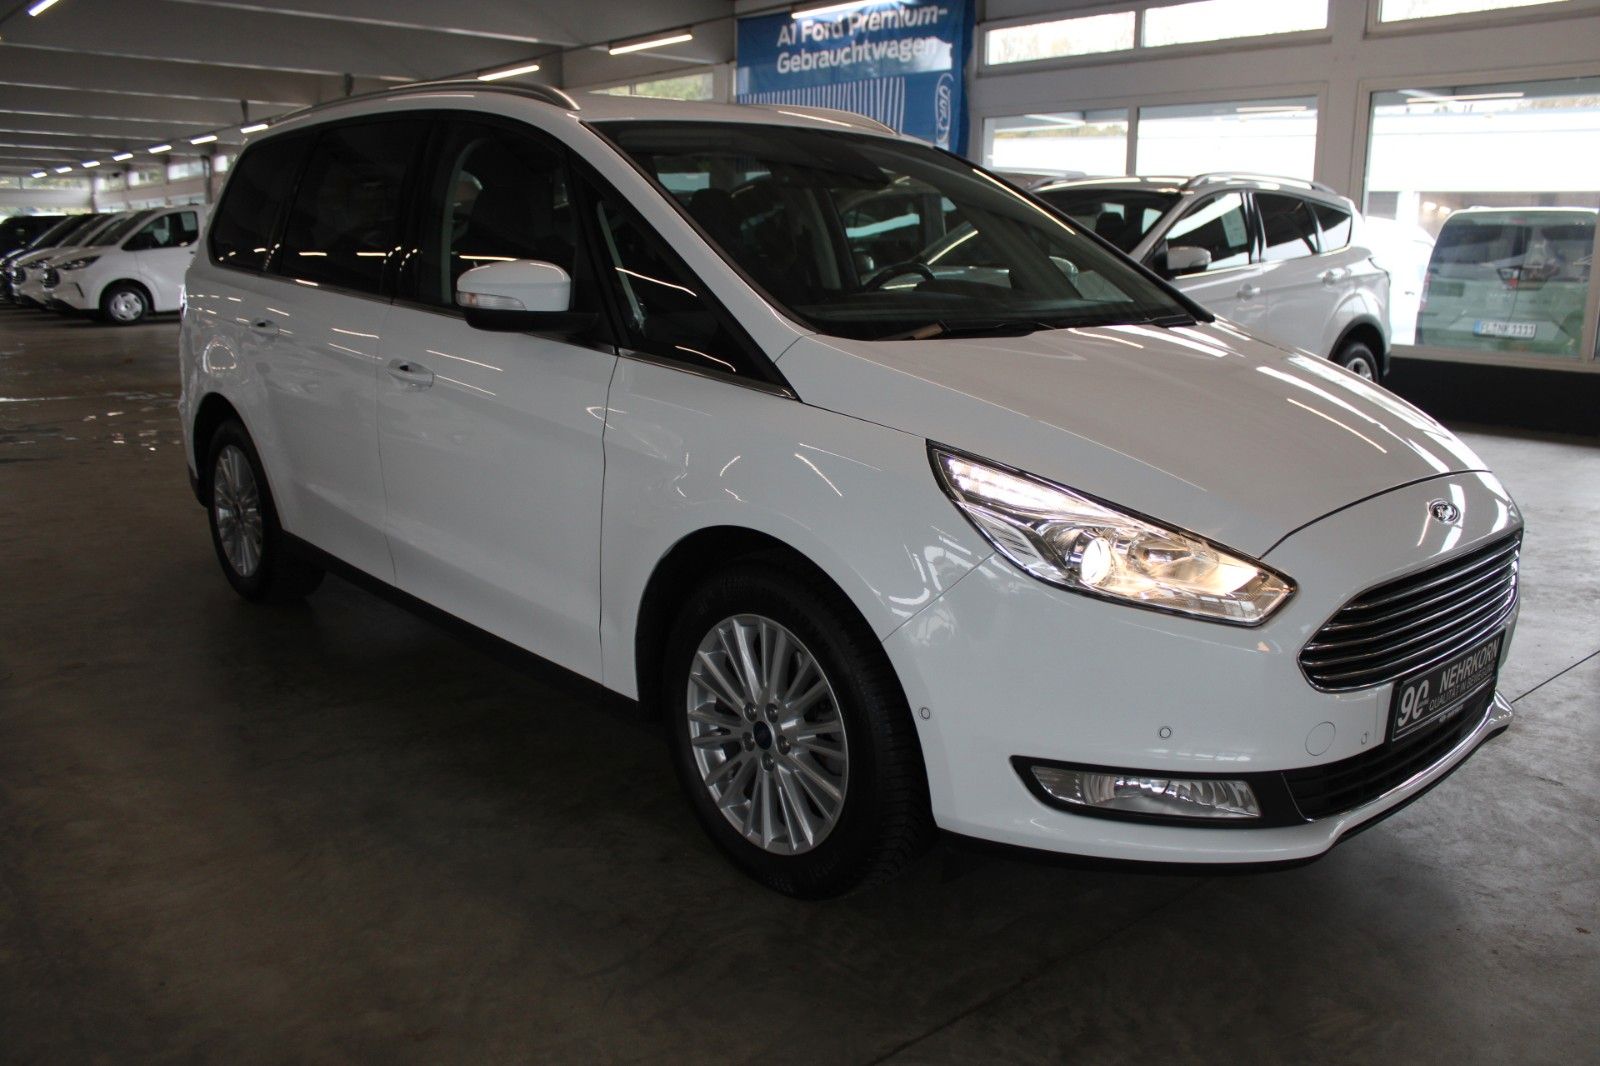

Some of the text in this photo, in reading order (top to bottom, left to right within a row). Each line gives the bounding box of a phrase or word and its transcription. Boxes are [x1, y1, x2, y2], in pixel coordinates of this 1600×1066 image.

[801, 15, 844, 43] Ford
[849, 5, 948, 36] Premium-
[777, 36, 937, 74] Gebrauchtwagen
[1440, 638, 1500, 693] NEHRKORN
